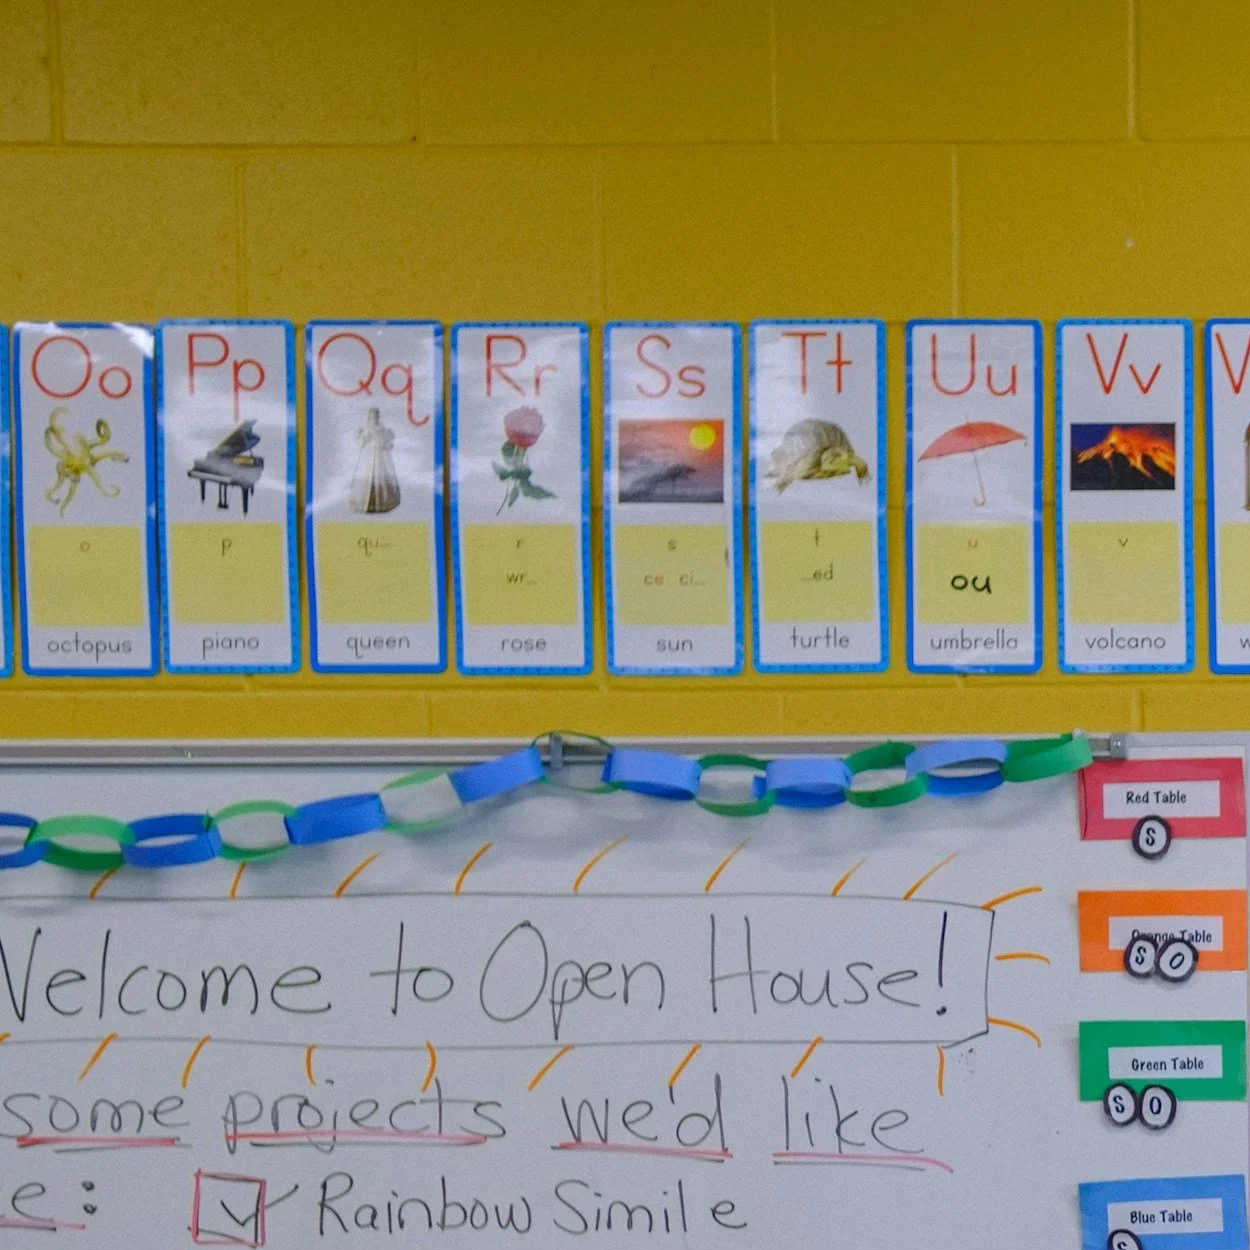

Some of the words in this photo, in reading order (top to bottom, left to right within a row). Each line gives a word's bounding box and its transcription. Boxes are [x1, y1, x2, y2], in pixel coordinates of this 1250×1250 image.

[31, 336, 132, 399] Oo
[186, 332, 265, 421] Pp
[484, 334, 559, 398] Rr
[636, 334, 706, 398] Ss
[781, 332, 852, 394] Tt
[930, 333, 1017, 396] Uu
[1085, 332, 1161, 394] Vv
[317, 332, 430, 426] Qq
[951, 573, 992, 594] ou
[47, 631, 132, 662] octopus
[202, 632, 260, 659] piano
[347, 634, 411, 660] queen
[500, 635, 547, 653] rose
[656, 636, 693, 653] sun
[790, 627, 850, 650] turtle
[930, 629, 1018, 650] umbrella
[1084, 629, 1165, 651] volcano
[1126, 791, 1149, 803] Red
[1154, 791, 1186, 804] Table
[1180, 929, 1212, 943] Table
[370, 922, 454, 1016] to
[480, 920, 665, 1040] Open
[709, 911, 947, 1016] House!
[1132, 1058, 1167, 1071] Green
[1172, 1058, 1204, 1070] Table
[0, 1092, 191, 1138] some
[223, 1078, 506, 1154] projects
[562, 1074, 729, 1154] we'd
[782, 1075, 925, 1154] like
[318, 1172, 532, 1237] Rainbow
[553, 1179, 746, 1236] Simile
[1130, 1211, 1155, 1223] Blue
[1160, 1210, 1193, 1222] Table
